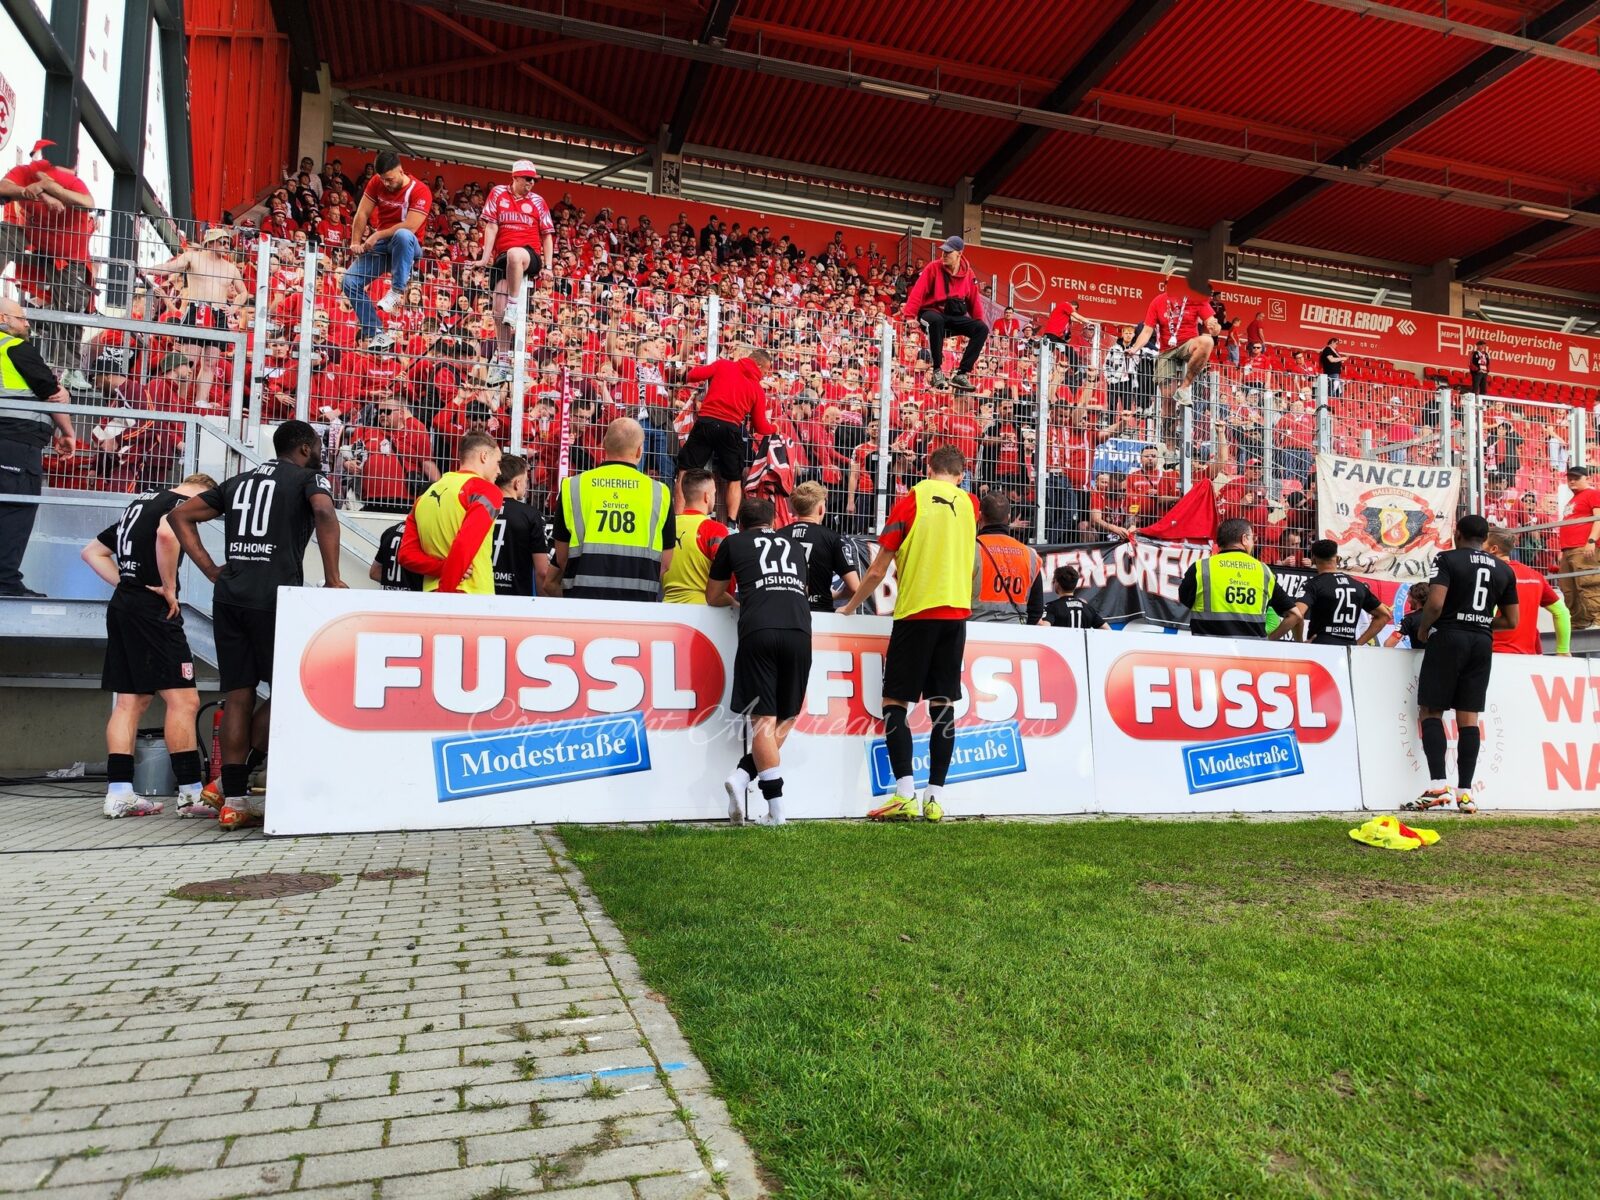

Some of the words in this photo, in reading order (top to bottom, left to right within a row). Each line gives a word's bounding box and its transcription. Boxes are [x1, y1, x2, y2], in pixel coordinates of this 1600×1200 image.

[1227, 256, 1234, 266] N
[1228, 268, 1234, 278] 2
[1050, 276, 1087, 292] STERN
[1098, 283, 1143, 299] CENTER
[1077, 294, 1117, 305] REGENSBURG
[1220, 292, 1262, 306] ENSTAUF
[1300, 303, 1394, 333] LEDERER.GROUP
[1464, 326, 1563, 351] Mittelbayerische
[1465, 343, 1556, 370] Plkatwerbung
[591, 478, 640, 489] SICHERHEIT
[1332, 460, 1452, 489] FANCLUB
[232, 479, 276, 537] 40
[602, 500, 629, 510] Service
[612, 492, 619, 500] &
[596, 510, 636, 533] 708
[1335, 502, 1350, 517] 19
[493, 519, 507, 567] 7
[791, 528, 807, 538] WOLF
[753, 537, 798, 575] 22
[800, 542, 813, 569] 7
[1219, 560, 1257, 570] SICHERHEIT
[993, 574, 1022, 595] 010
[1225, 586, 1256, 605] 658
[1228, 578, 1250, 587] Service
[1472, 567, 1491, 612] 6
[1332, 587, 1357, 624] 25
[353, 632, 698, 715] FUSSL
[805, 650, 1058, 723] FUSL
[1132, 665, 1328, 730] FUSSL
[1399, 712, 1420, 772] NATUR
[1489, 703, 1505, 774] GENUSS
[460, 732, 628, 780] Modestraße
[1197, 745, 1290, 777] Modestraße
